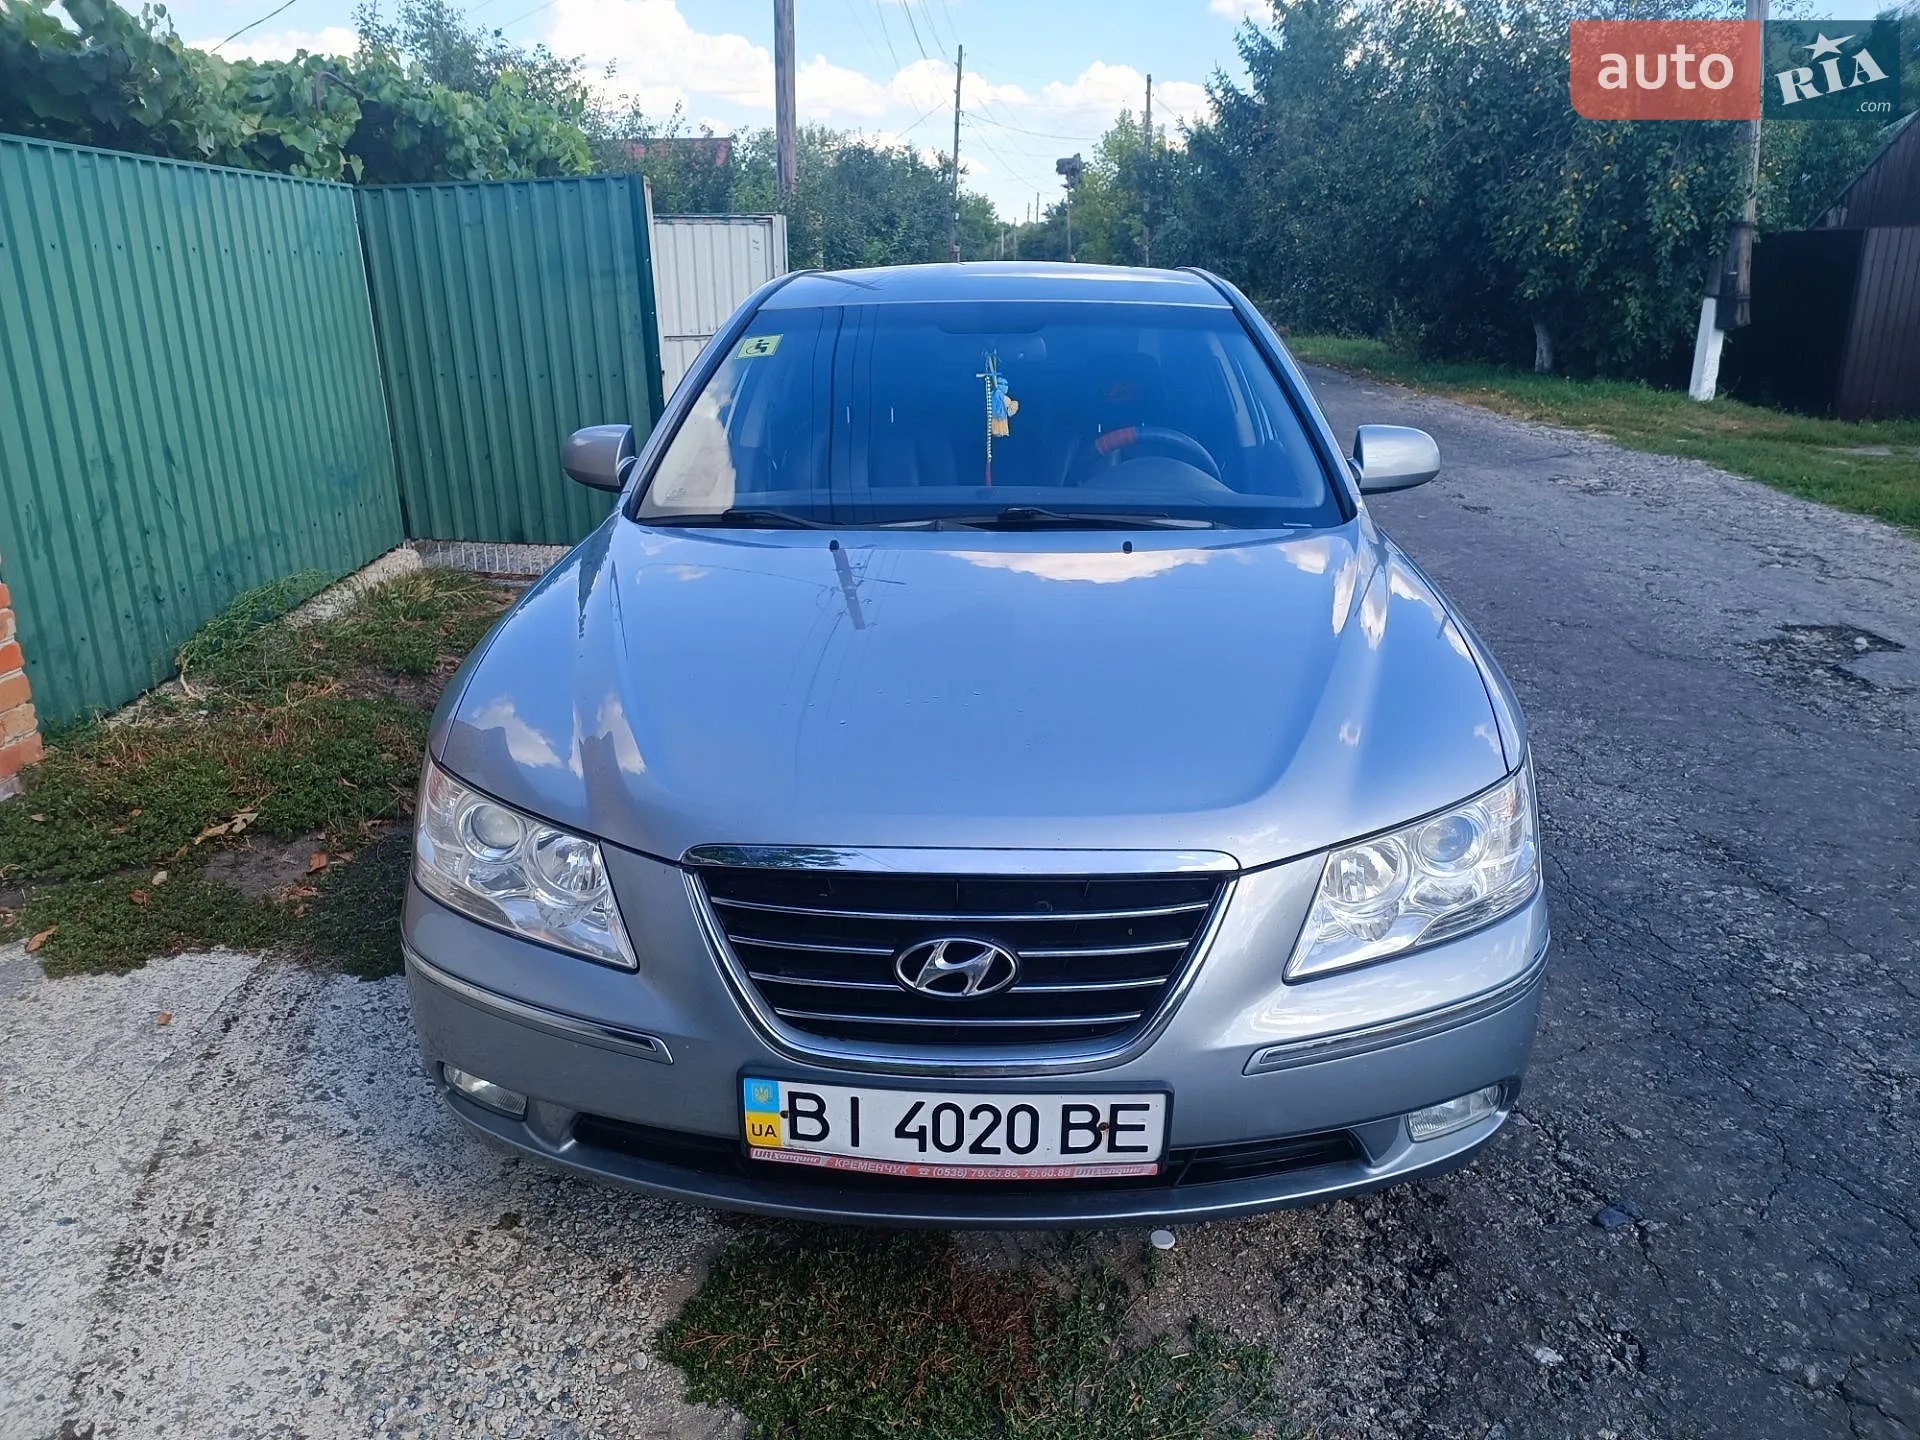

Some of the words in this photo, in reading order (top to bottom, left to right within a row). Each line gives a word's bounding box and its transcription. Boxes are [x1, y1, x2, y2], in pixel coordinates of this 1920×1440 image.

[751, 1123, 777, 1139] UA
[894, 1100, 1040, 1155] 4020
[1060, 1103, 1151, 1154] BE
[834, 1159, 907, 1175] КРЕМЕНЧУК
